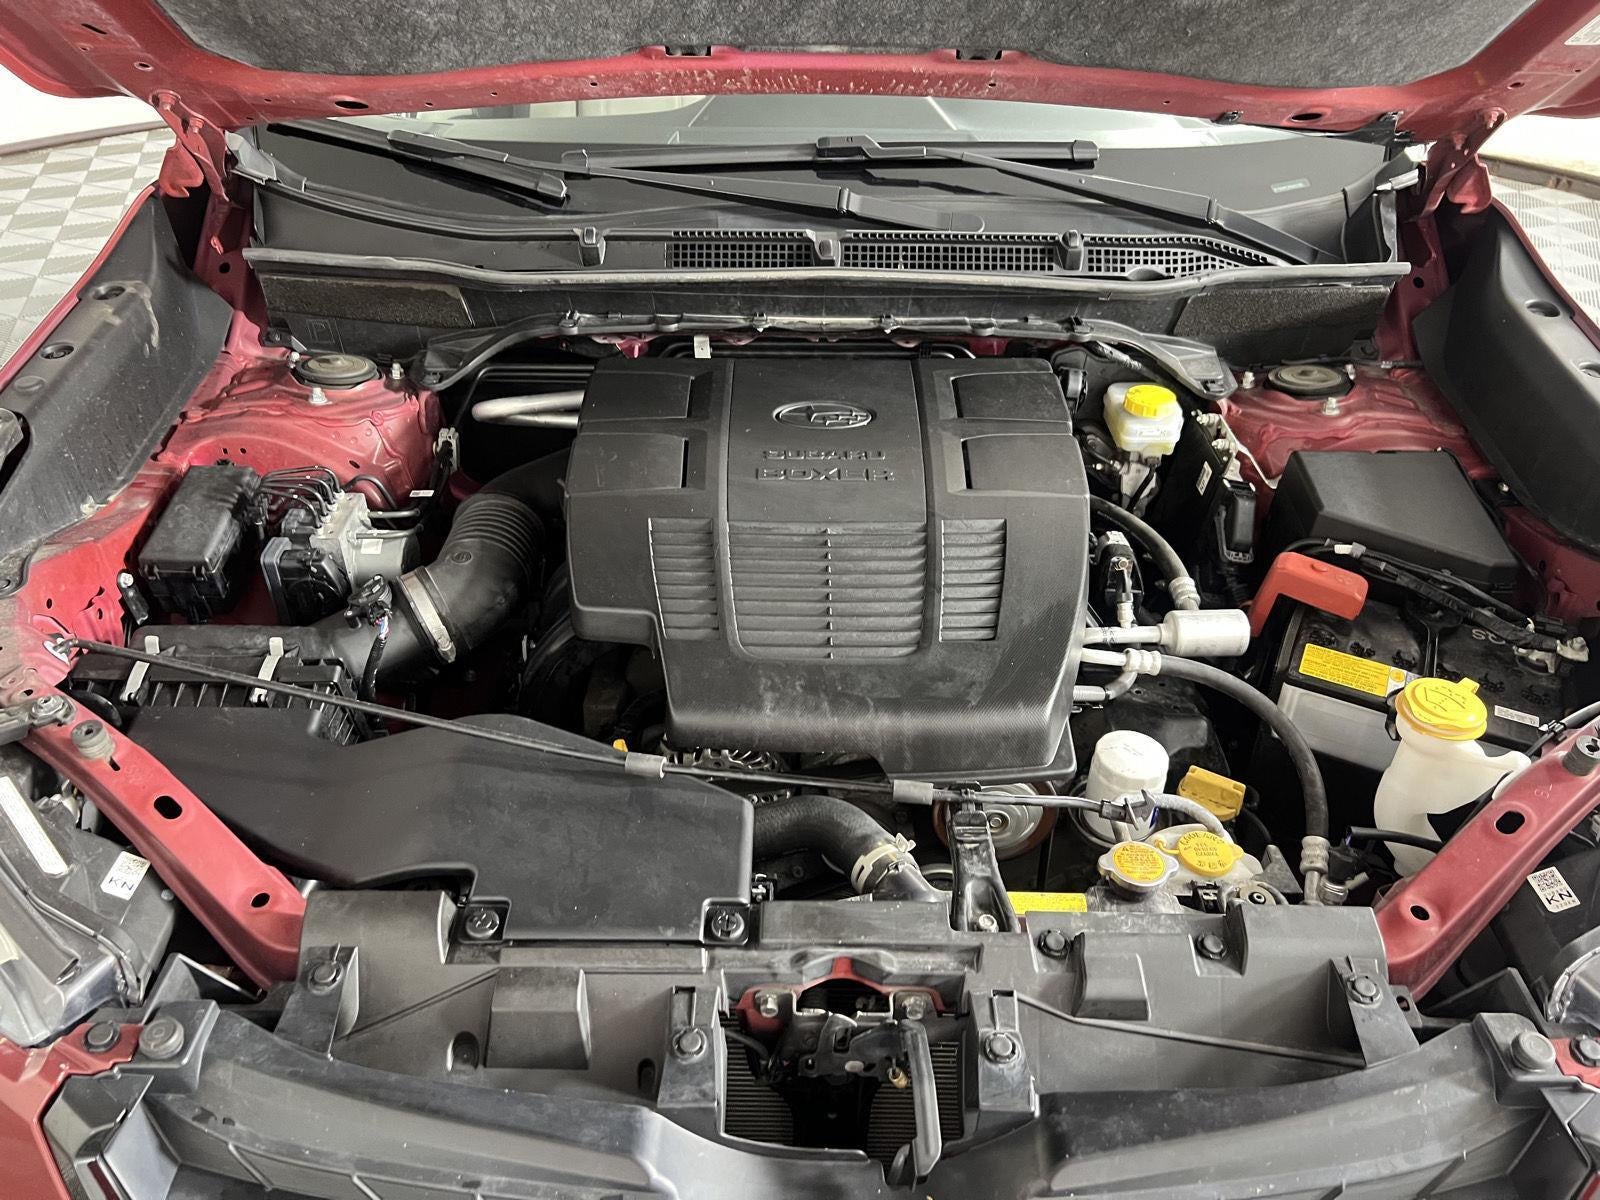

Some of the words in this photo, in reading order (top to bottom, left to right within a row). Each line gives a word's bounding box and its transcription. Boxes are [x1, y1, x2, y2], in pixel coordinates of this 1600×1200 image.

[763, 450, 886, 460] SUBARU
[756, 467, 896, 481] BOXER
[1545, 890, 1573, 905] KN
